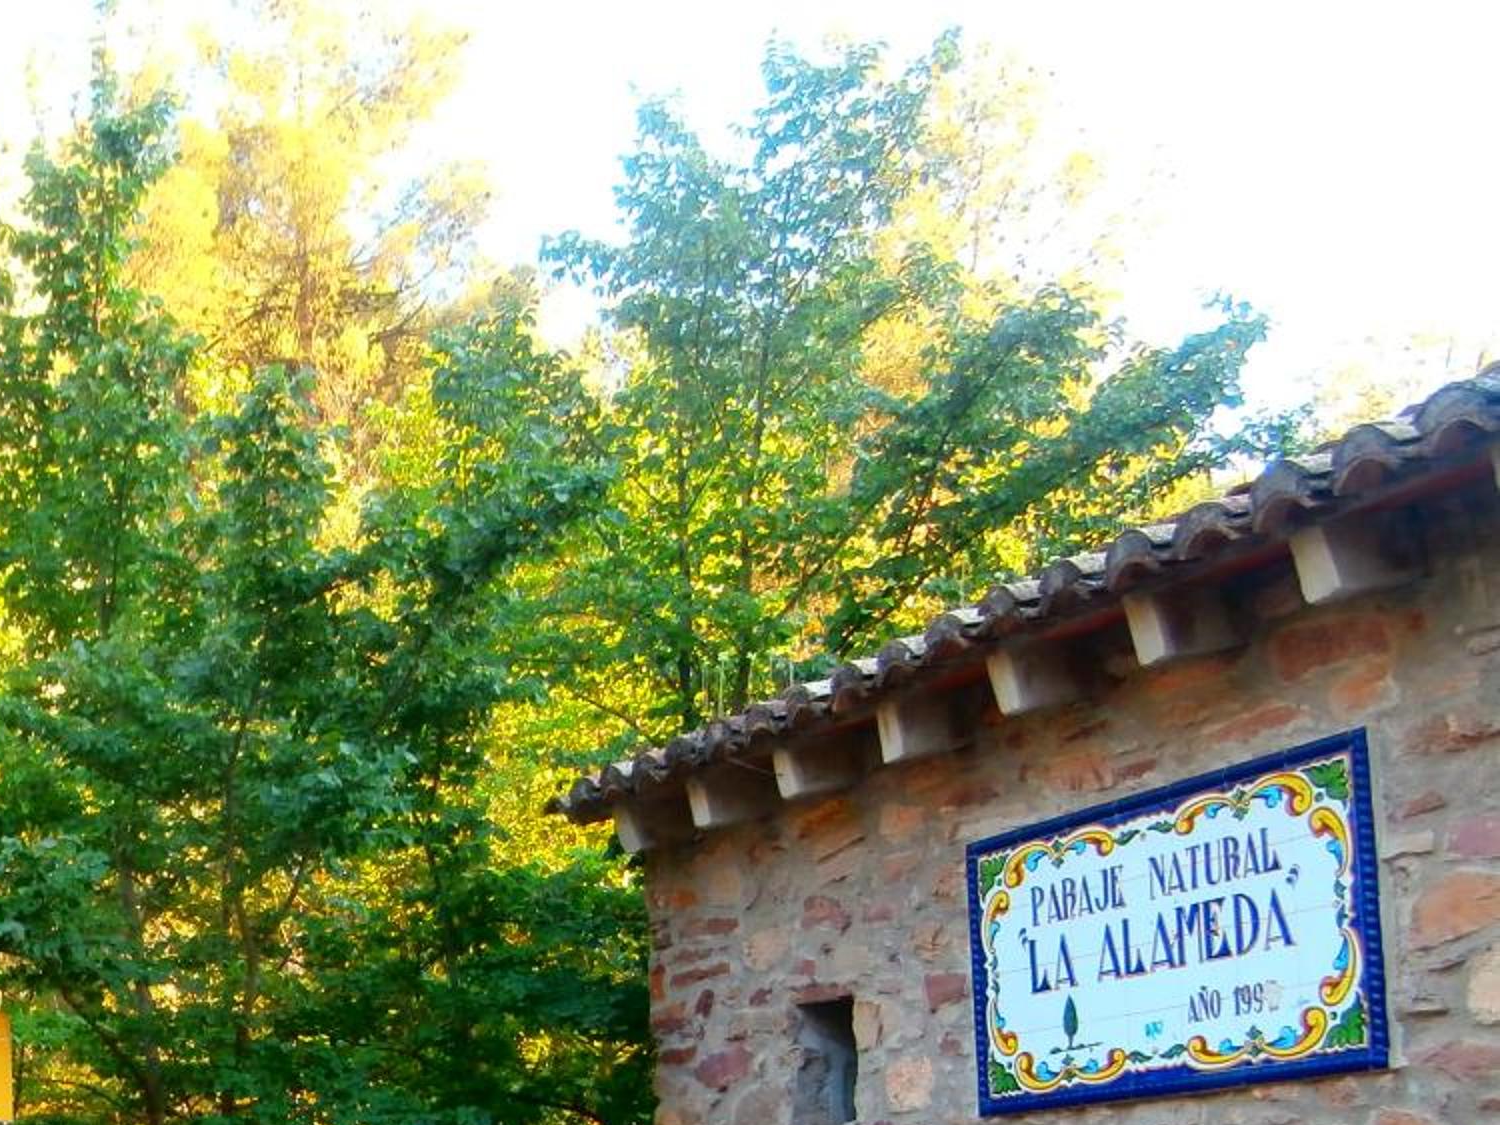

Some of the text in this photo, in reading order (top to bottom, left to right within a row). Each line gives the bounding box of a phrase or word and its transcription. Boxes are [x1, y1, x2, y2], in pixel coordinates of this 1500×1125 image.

[1030, 827, 1282, 926] PARAJE NATURAL
[1188, 985, 1221, 1022] AÑO
